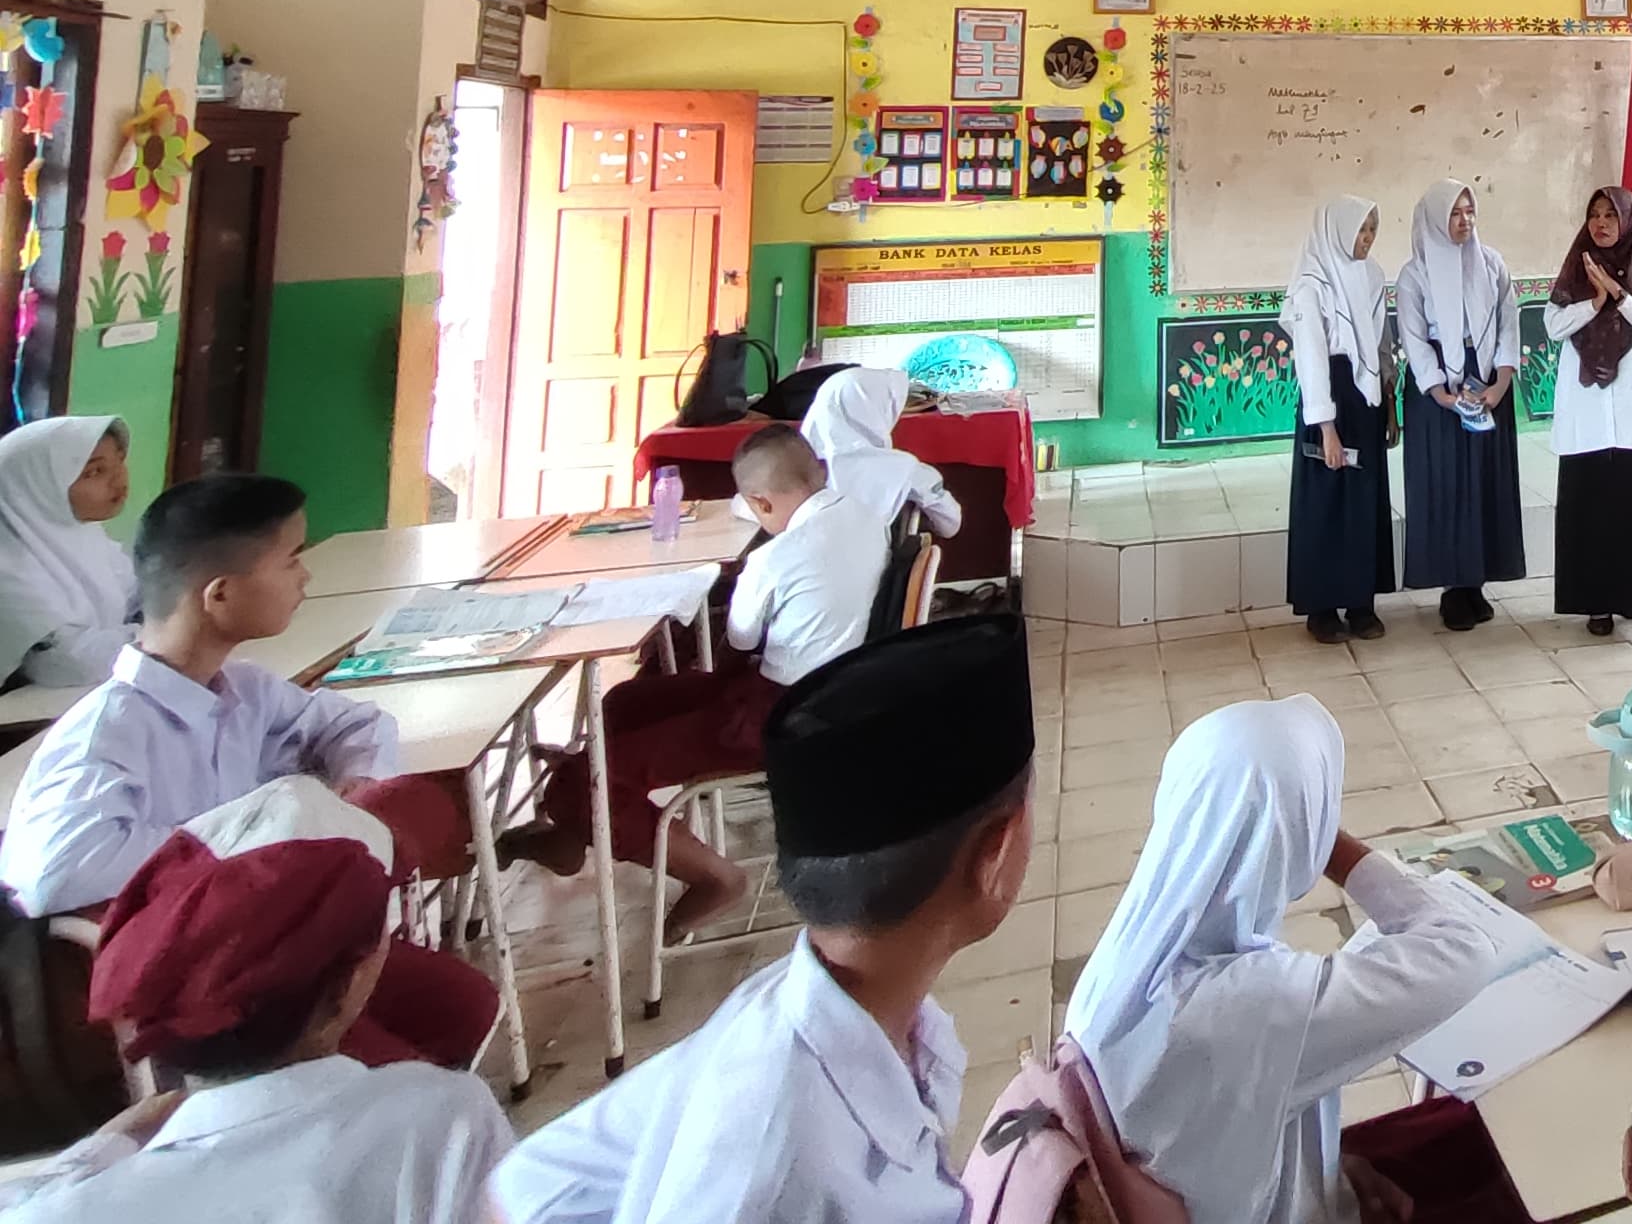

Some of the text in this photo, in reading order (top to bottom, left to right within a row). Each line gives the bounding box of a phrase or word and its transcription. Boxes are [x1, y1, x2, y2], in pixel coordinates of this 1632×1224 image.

[879, 245, 1043, 260] BANK DATA KELAS
